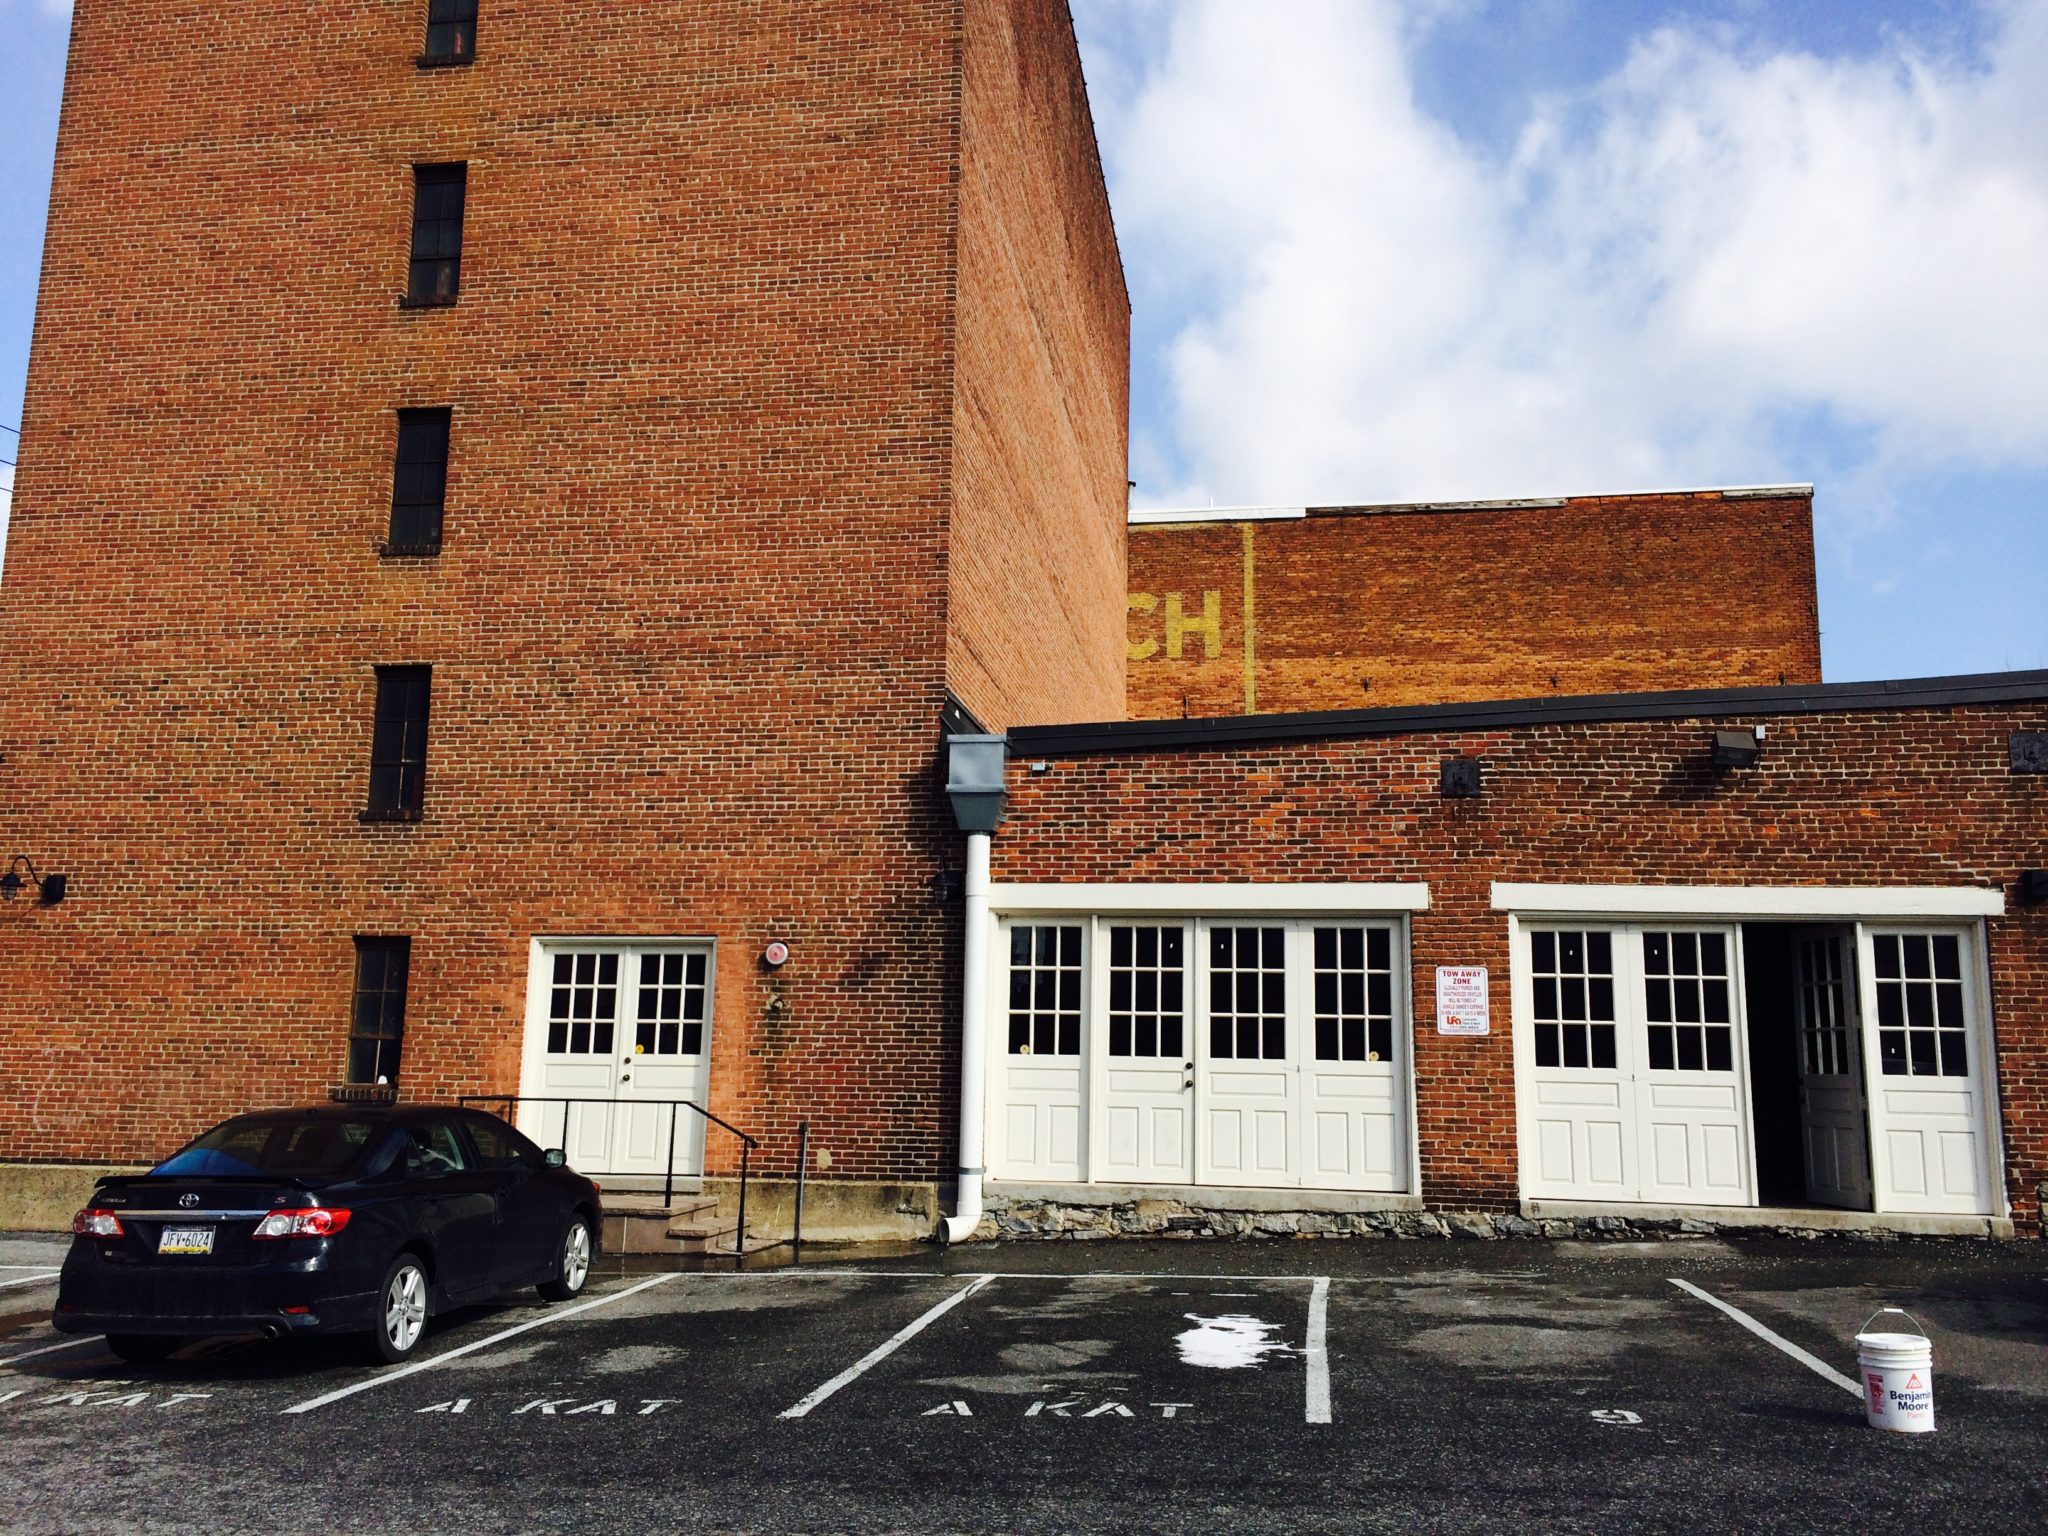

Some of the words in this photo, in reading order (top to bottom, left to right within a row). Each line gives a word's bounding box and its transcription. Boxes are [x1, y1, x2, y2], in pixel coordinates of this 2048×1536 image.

[413, 1398, 472, 1413] A
[510, 1398, 683, 1415] KAT
[920, 1400, 974, 1416] A
[1024, 1400, 1194, 1418] KAT
[1898, 1401, 1928, 1410] Moore
